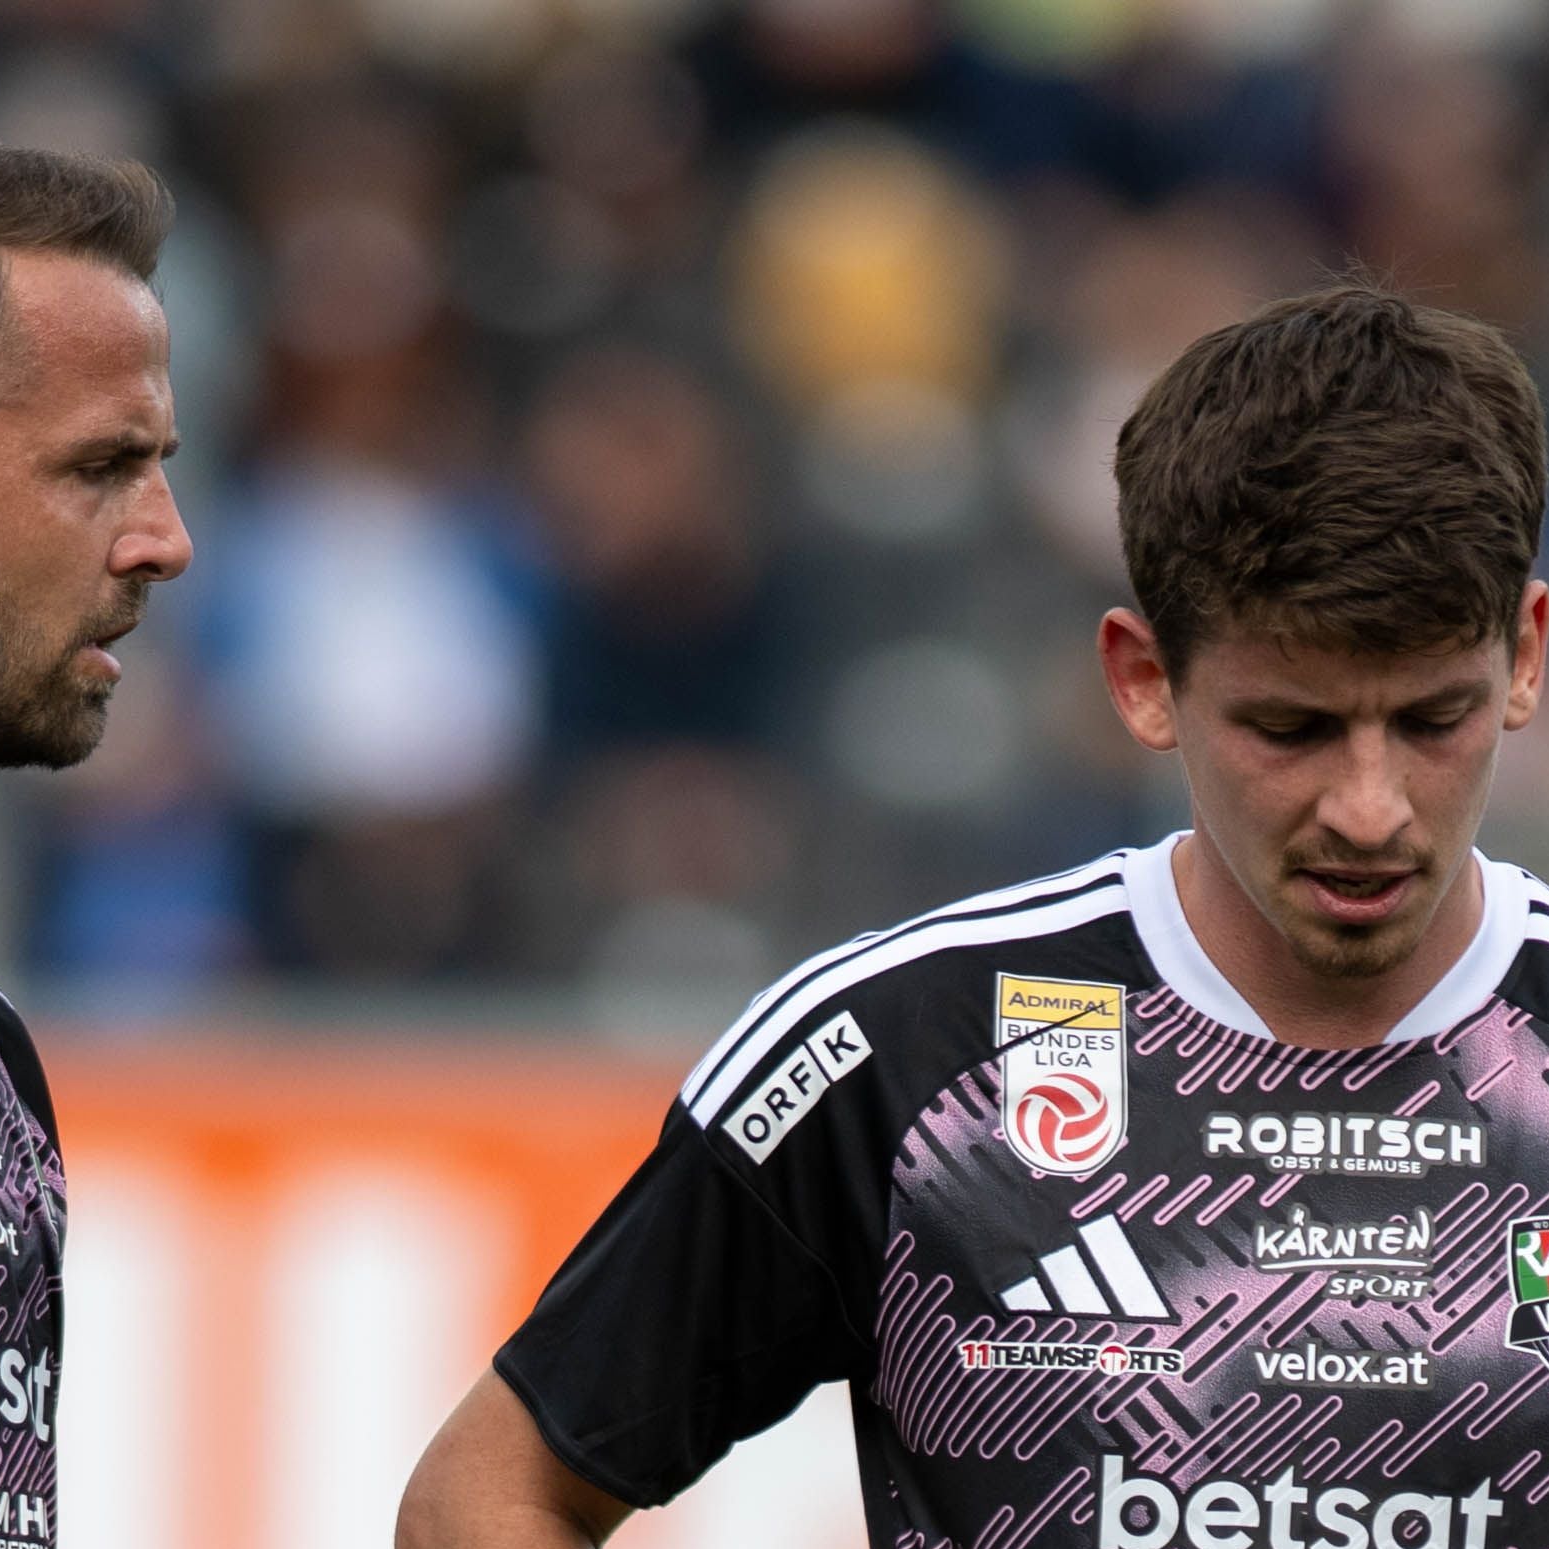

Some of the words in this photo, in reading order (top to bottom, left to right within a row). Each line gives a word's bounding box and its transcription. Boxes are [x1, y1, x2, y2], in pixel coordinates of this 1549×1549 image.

[1009, 991, 1116, 1016] ADMIRAL
[1007, 1023, 1116, 1051] BUNDES
[1035, 1050, 1093, 1068] LIGA
[1207, 1116, 1482, 1164] ROBITSCH
[1269, 1154, 1323, 1169] OBST
[1256, 1209, 1430, 1259] KÄRNTEN
[1328, 1274, 1428, 1298] SPORT
[962, 1343, 1182, 1374] 11TEAMSPORTS
[1254, 1344, 1428, 1385] velox.at
